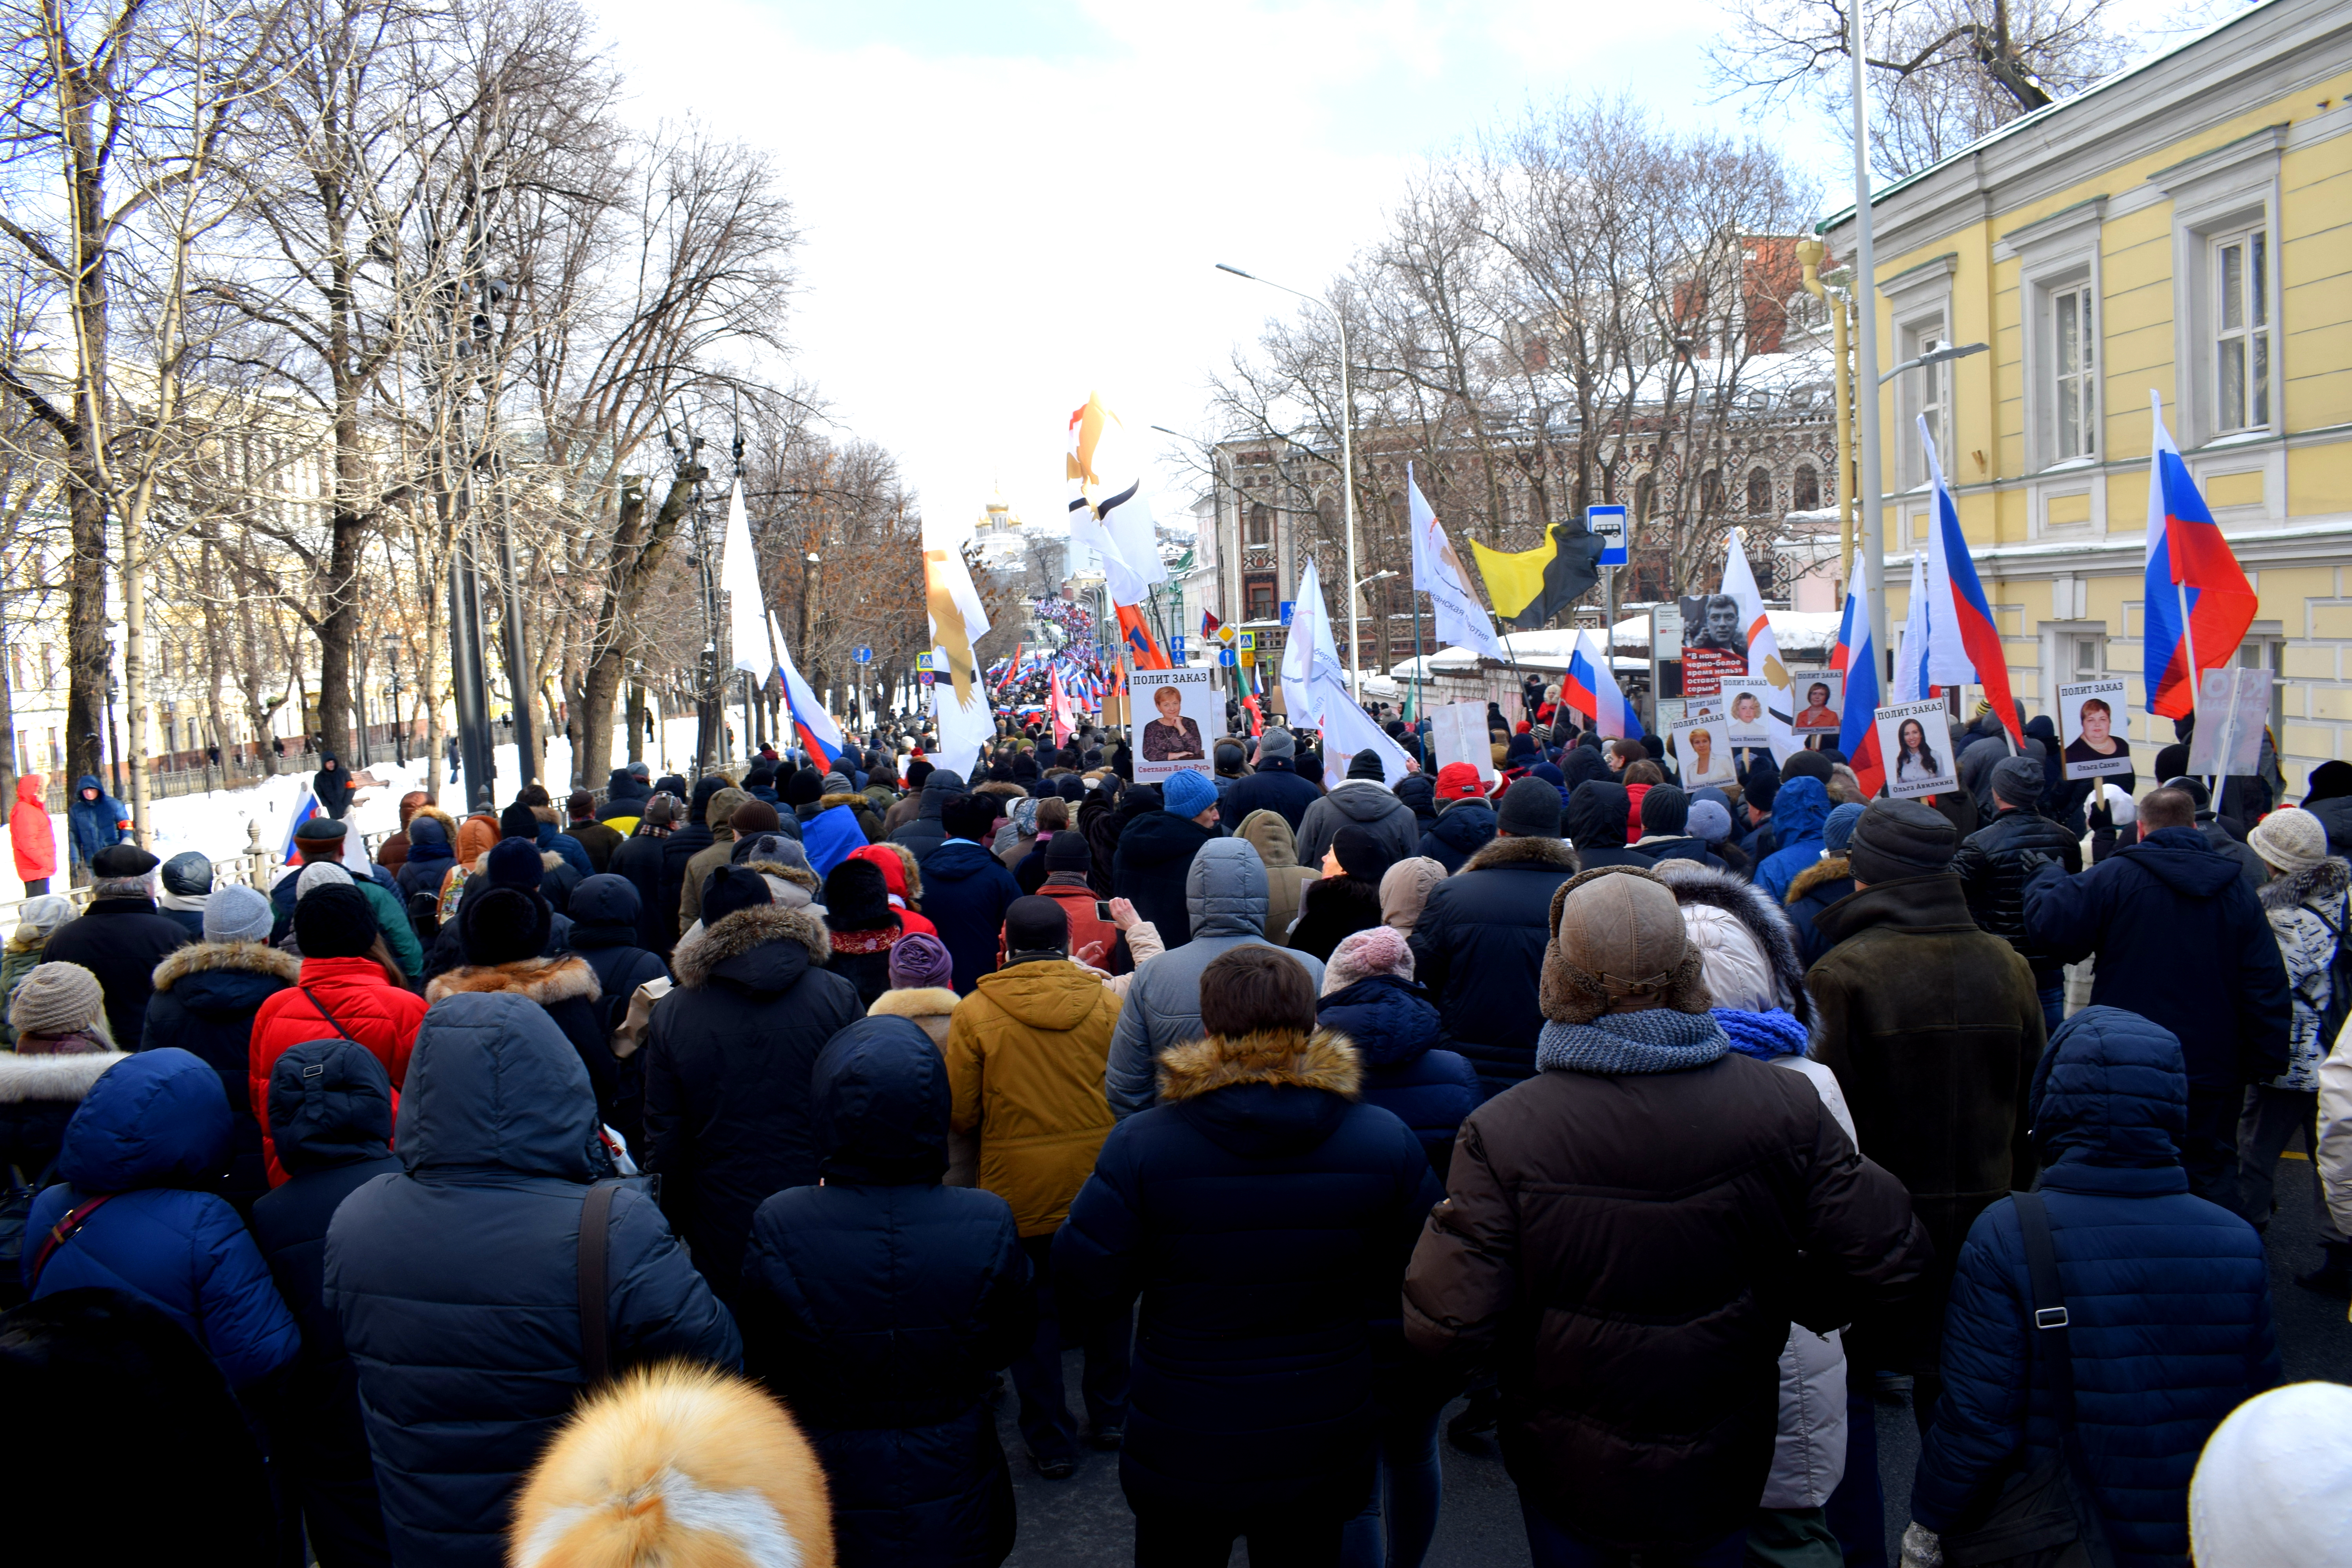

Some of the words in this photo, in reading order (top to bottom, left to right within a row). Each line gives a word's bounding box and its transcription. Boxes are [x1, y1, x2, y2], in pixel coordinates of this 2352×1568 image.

[1428, 589, 1465, 616] ианская
[1686, 659, 1741, 669] черно-белое
[1133, 675, 1170, 685] ПОЛИТ
[1172, 673, 1207, 683] ЗАКАЗ
[2061, 686, 2092, 696] ПОЛИТ
[2094, 682, 2123, 693] ЗАКАЗ
[1877, 708, 1909, 720] ПОЛИТ
[1912, 702, 1943, 715] ЗАКАЗ
[1673, 719, 1698, 729] ПОЛИТ
[1700, 714, 1724, 724] ЗАКАЗ
[1916, 779, 1954, 789] Авилкина
